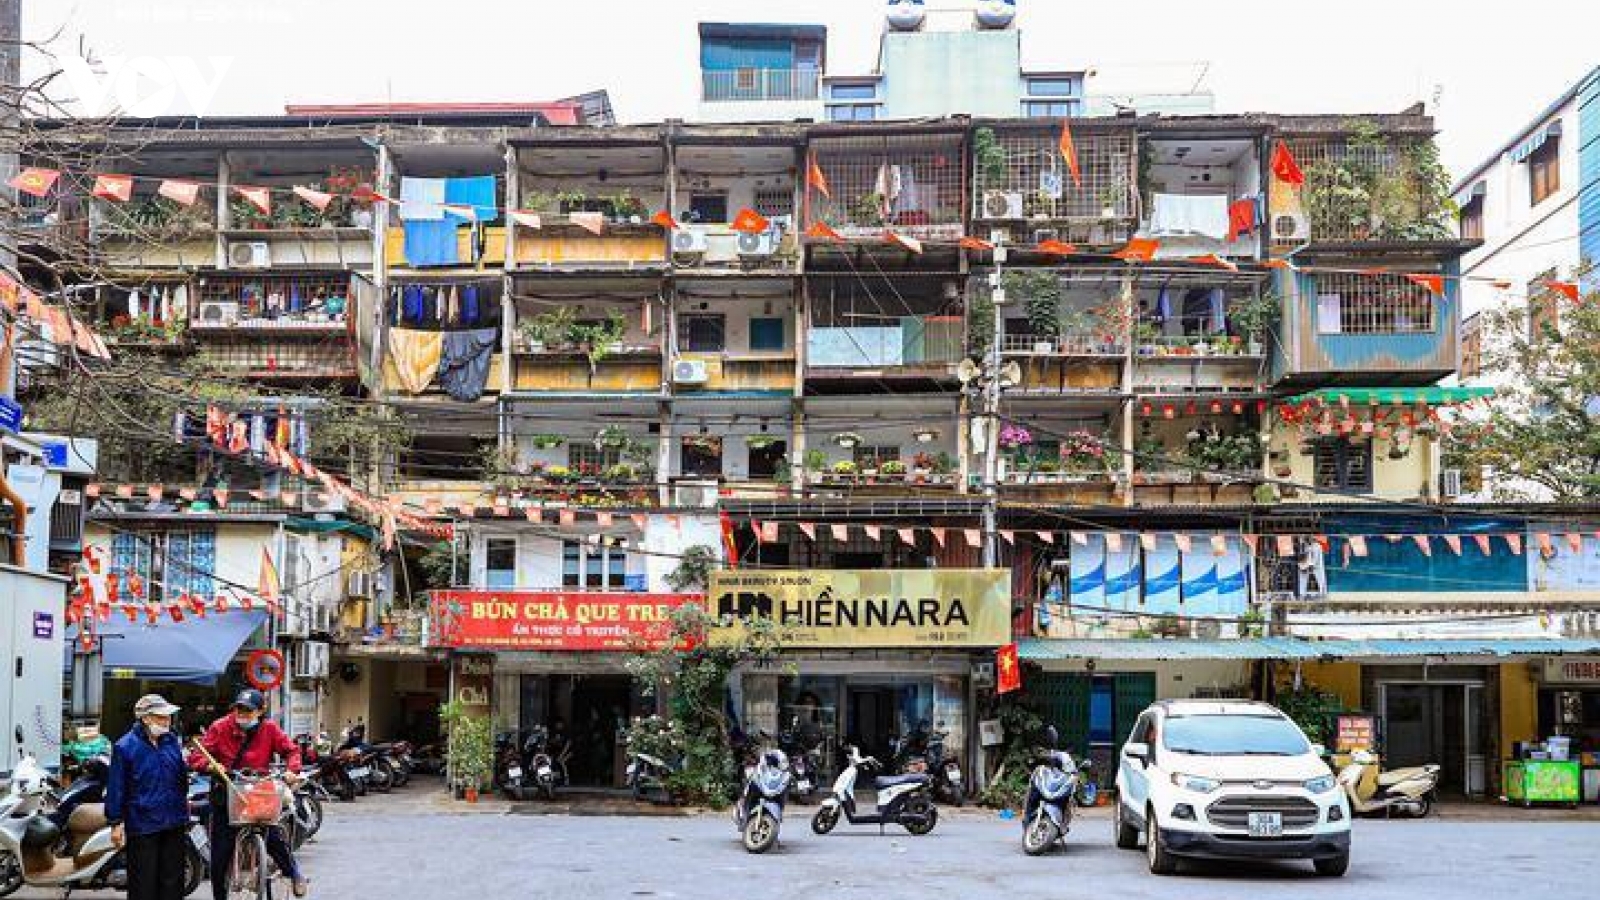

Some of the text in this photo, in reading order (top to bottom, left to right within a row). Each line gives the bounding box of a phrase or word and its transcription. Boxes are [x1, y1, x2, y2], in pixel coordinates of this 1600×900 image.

[741, 577, 778, 586] BEAUTY
[781, 577, 812, 586] SALON
[471, 598, 517, 620] BÚN
[524, 596, 569, 620] CHẢ
[626, 602, 669, 621] TRE
[866, 599, 970, 626] NARA
